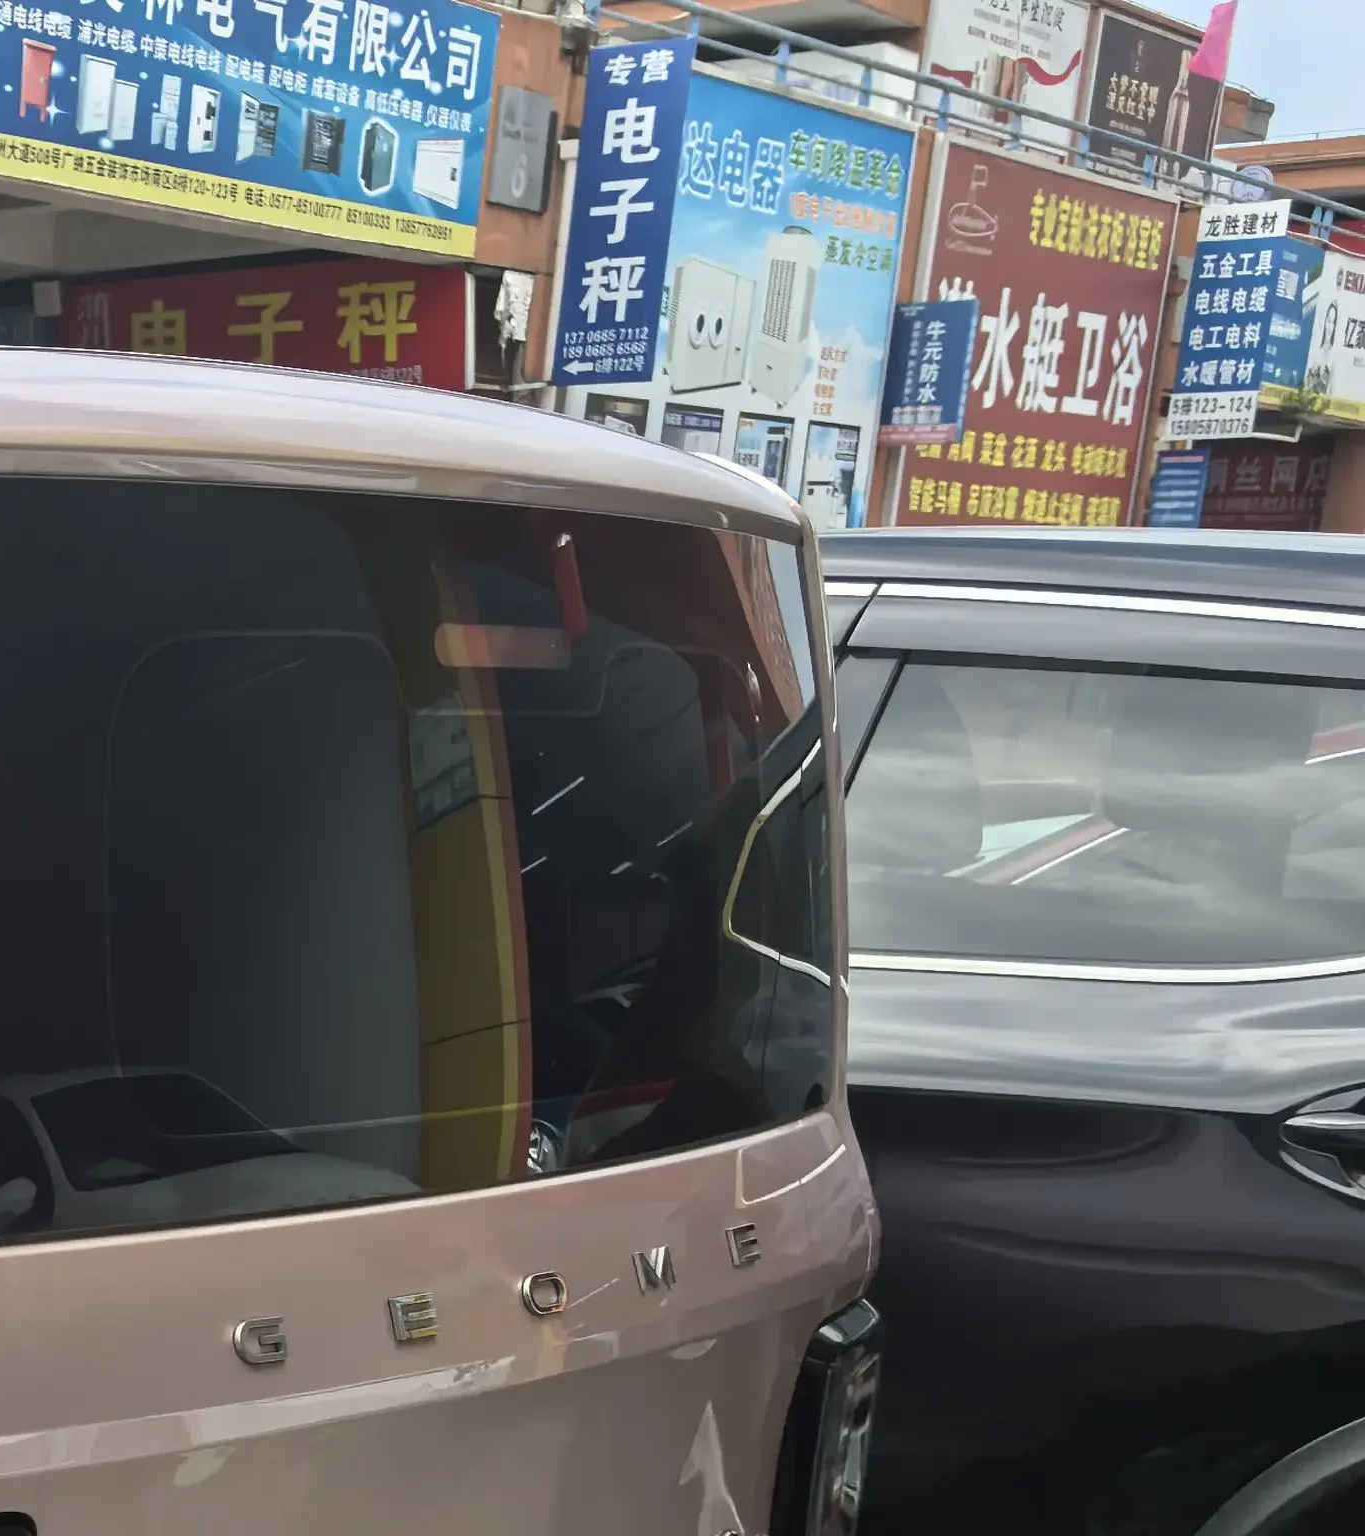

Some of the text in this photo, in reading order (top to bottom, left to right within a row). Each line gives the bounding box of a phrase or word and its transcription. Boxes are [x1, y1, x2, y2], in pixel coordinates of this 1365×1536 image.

[604, 50, 674, 87] 专营
[579, 97, 660, 324] 电子秤
[1204, 211, 1279, 238] 龙胜建材
[1199, 249, 1273, 280] 五金工具
[1194, 285, 1269, 316] 电线电缆
[130, 280, 418, 366] 电子秤
[1188, 321, 1262, 352] 电工电料
[916, 320, 947, 404] 牛元防水
[939, 276, 1148, 427] 水艇卫浴
[1181, 358, 1255, 388] 水暖管材
[232, 1221, 763, 1366] GEOME
